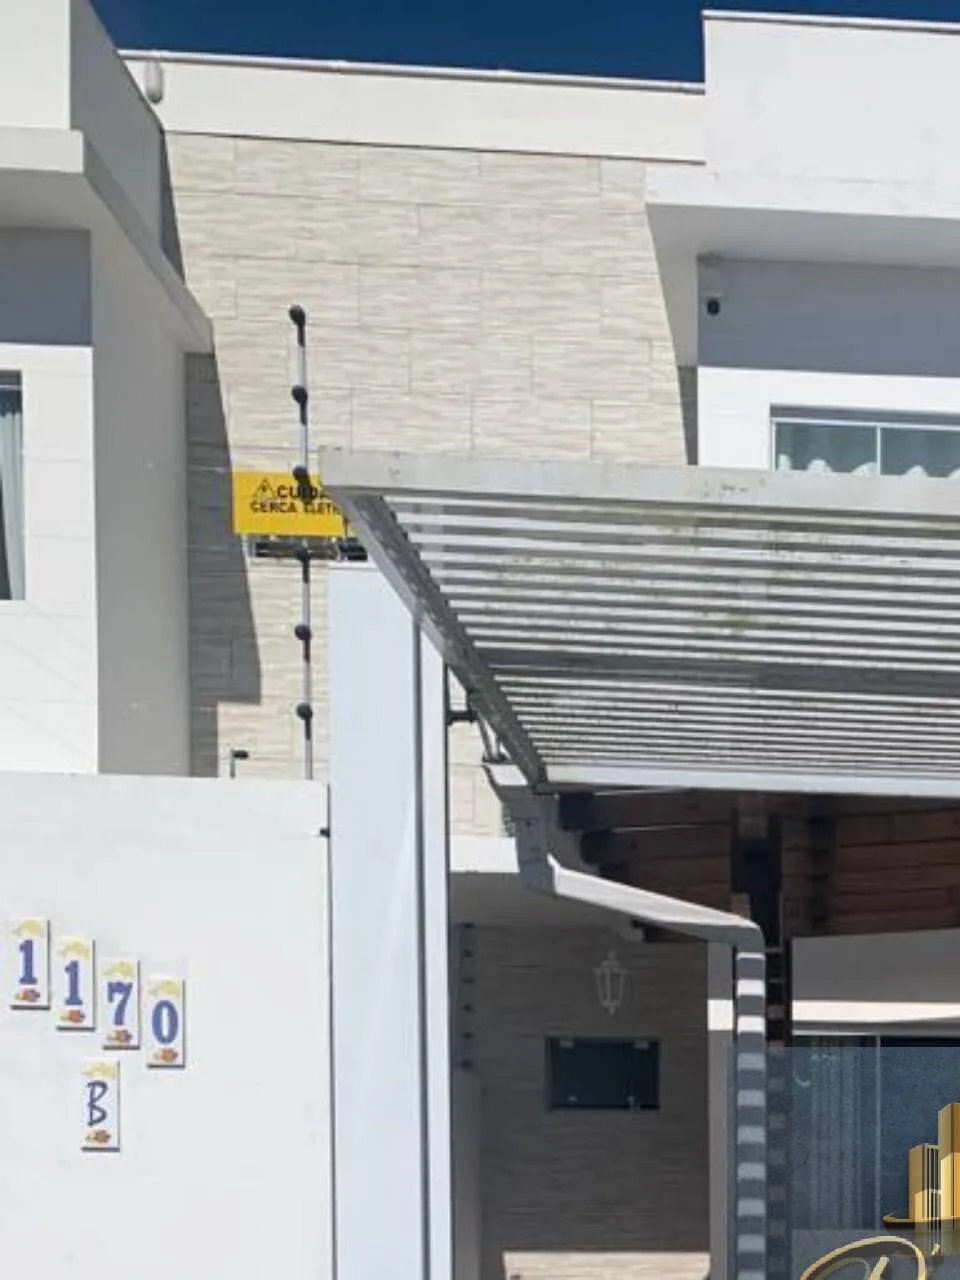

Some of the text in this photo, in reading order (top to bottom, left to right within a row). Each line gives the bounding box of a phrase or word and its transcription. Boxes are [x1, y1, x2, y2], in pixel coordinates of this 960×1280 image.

[250, 500, 297, 513] CERCA
[19, 939, 179, 1045] 1170
[86, 1080, 109, 1128] B
